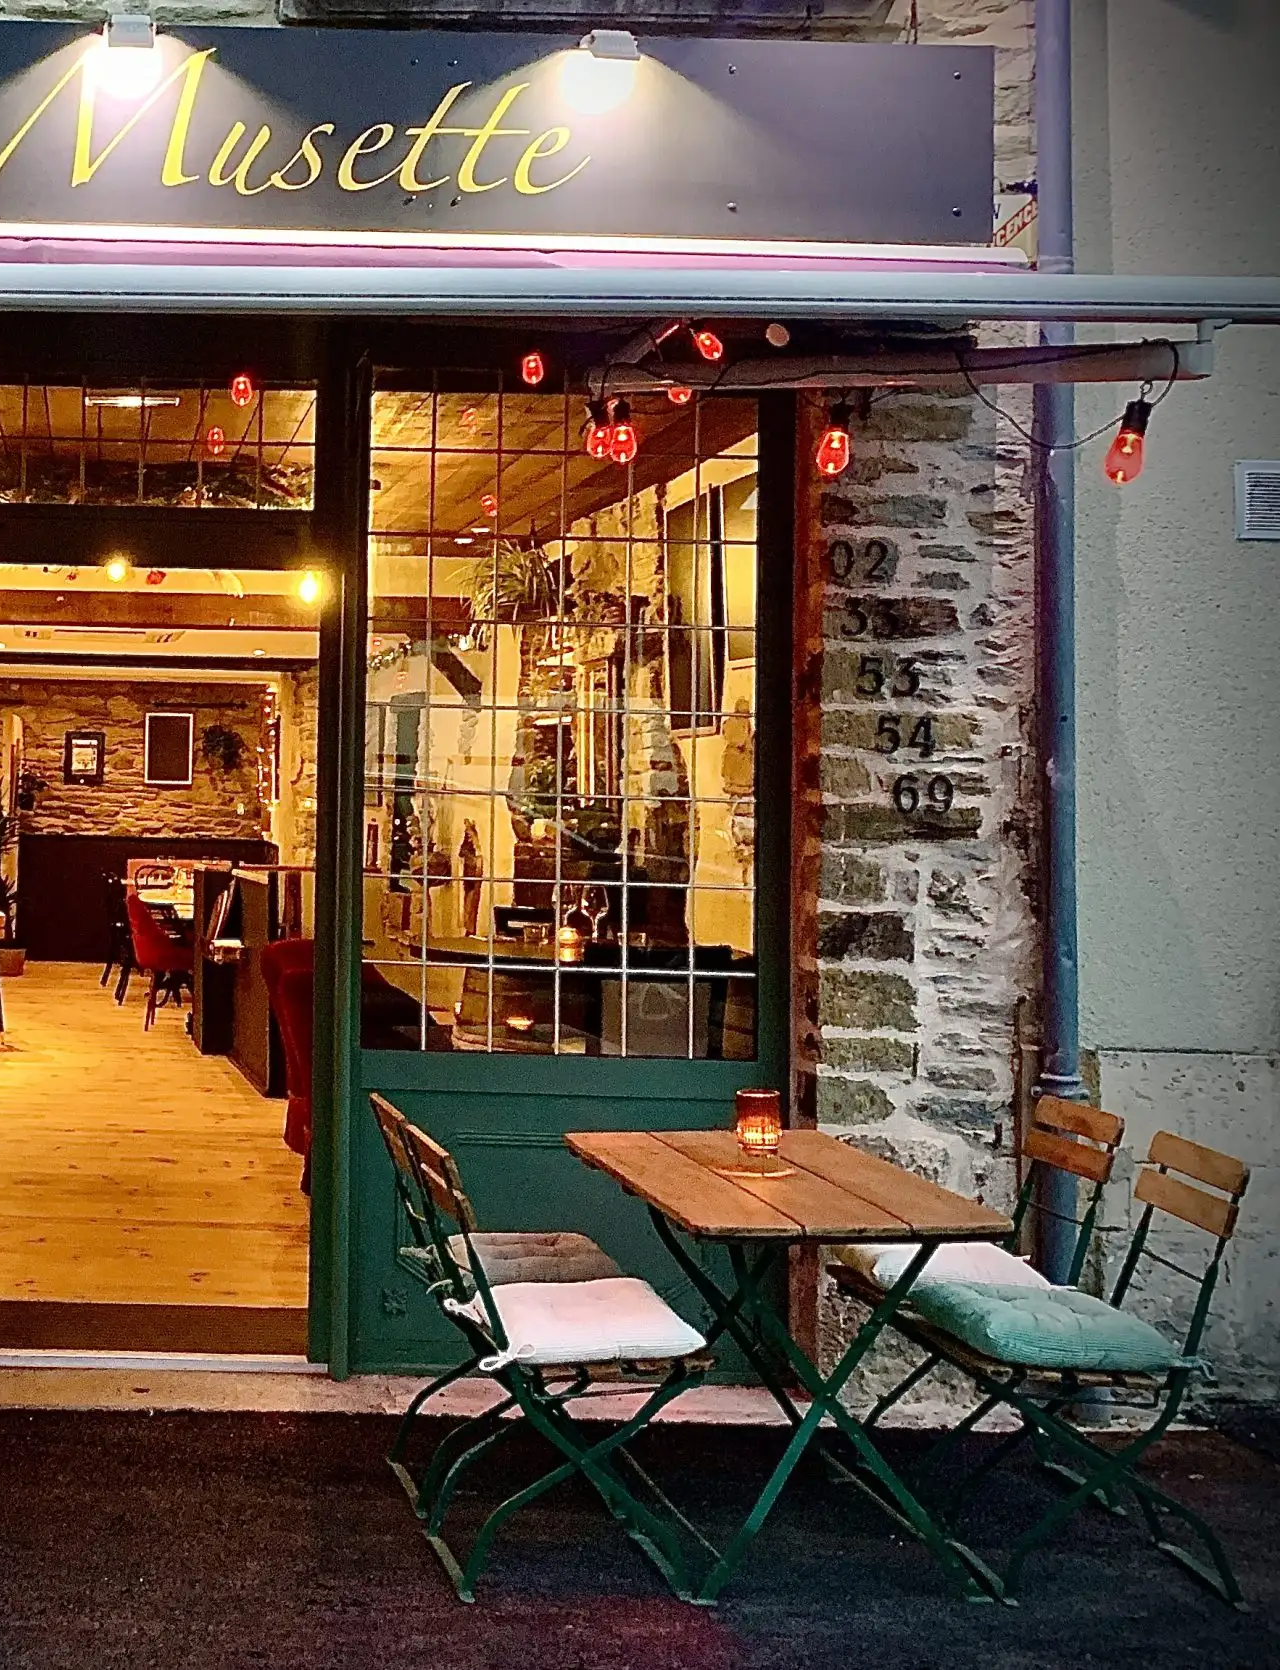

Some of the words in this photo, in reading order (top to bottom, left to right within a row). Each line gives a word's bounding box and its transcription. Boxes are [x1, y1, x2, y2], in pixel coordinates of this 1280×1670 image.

[829, 539, 888, 583] 02
[856, 655, 920, 697] 53
[875, 714, 935, 757] 54
[893, 773, 953, 814] 69
